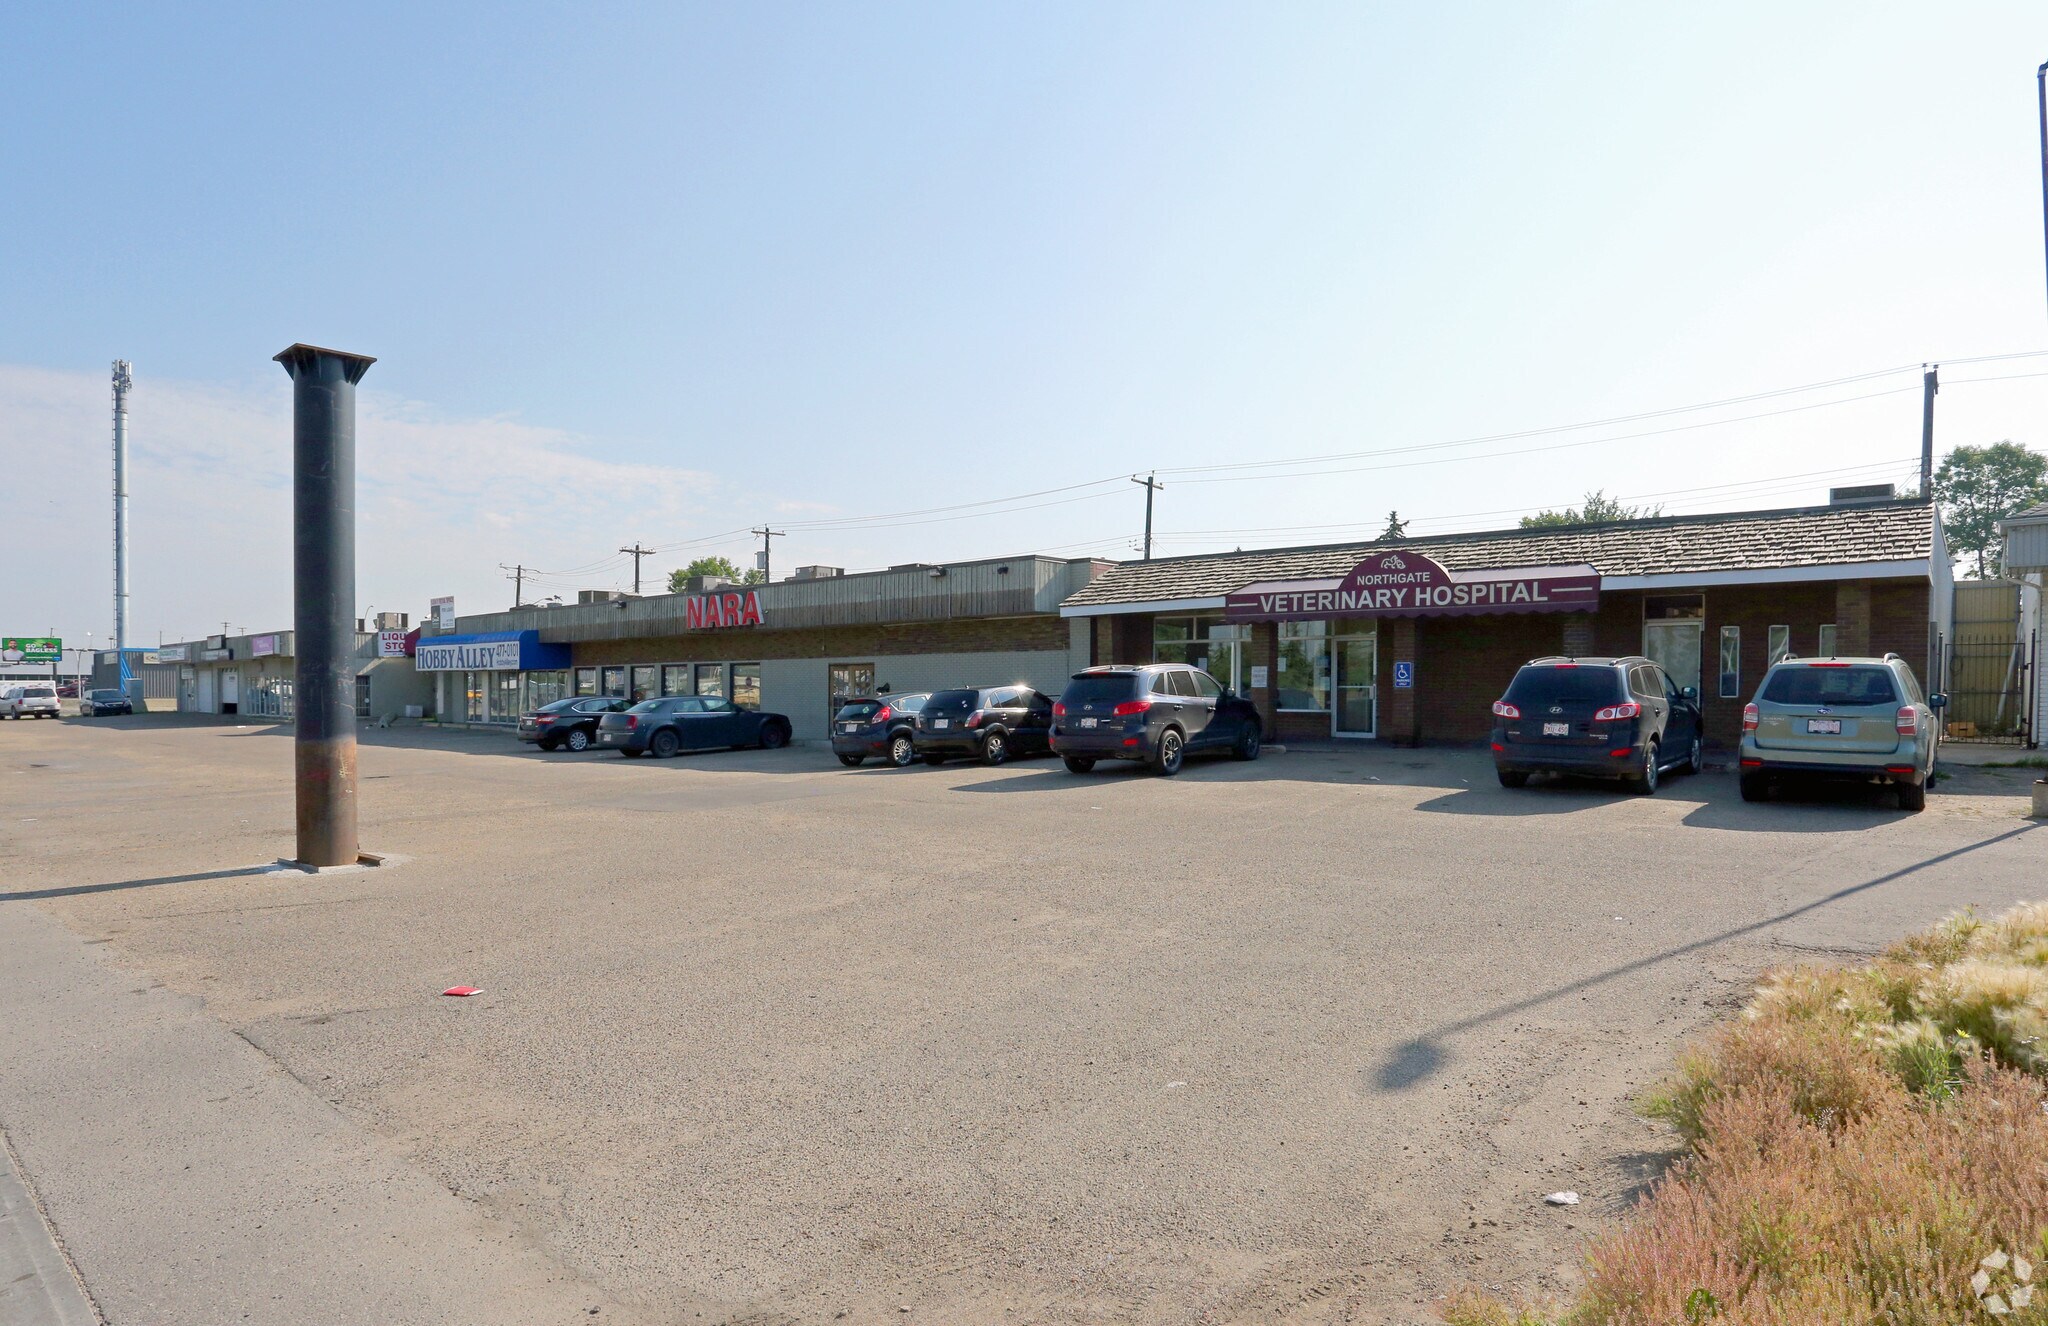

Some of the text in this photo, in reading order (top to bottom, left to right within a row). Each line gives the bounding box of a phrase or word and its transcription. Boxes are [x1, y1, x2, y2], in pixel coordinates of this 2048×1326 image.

[1357, 571, 1431, 586] NORTHGATE
[1260, 582, 1548, 613] VETERINARY HOSPITAL
[687, 591, 765, 630] NARA
[417, 645, 495, 669] HOBBY ALLEY
[496, 643, 519, 658] 477-0101
